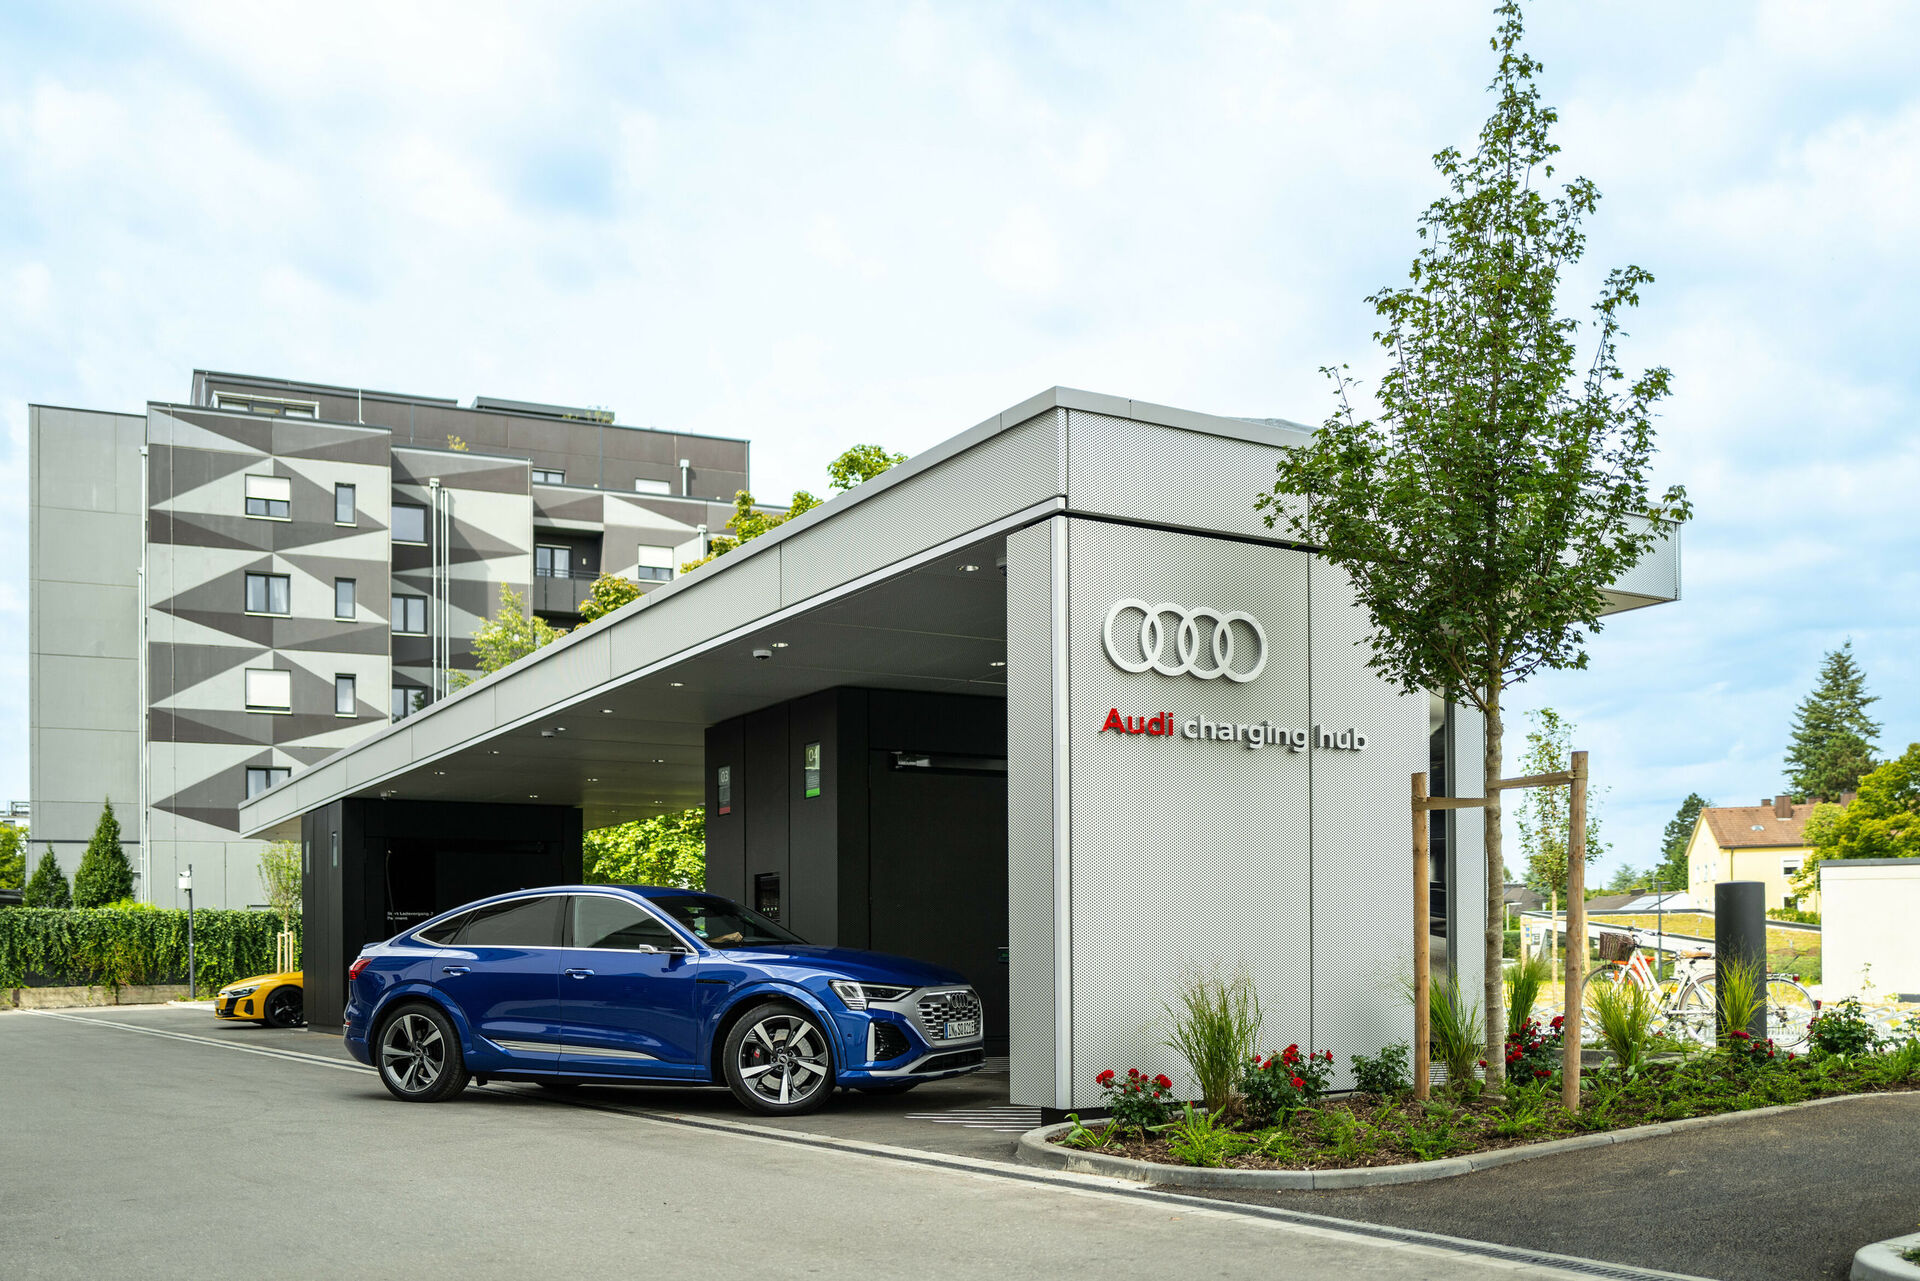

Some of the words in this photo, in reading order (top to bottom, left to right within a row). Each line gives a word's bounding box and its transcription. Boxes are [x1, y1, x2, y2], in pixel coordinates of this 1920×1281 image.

[1100, 707, 1174, 736] Audi
[1183, 714, 1309, 752] charging
[1317, 723, 1369, 750] hub
[808, 749, 818, 761] 04
[720, 770, 729, 783] 03
